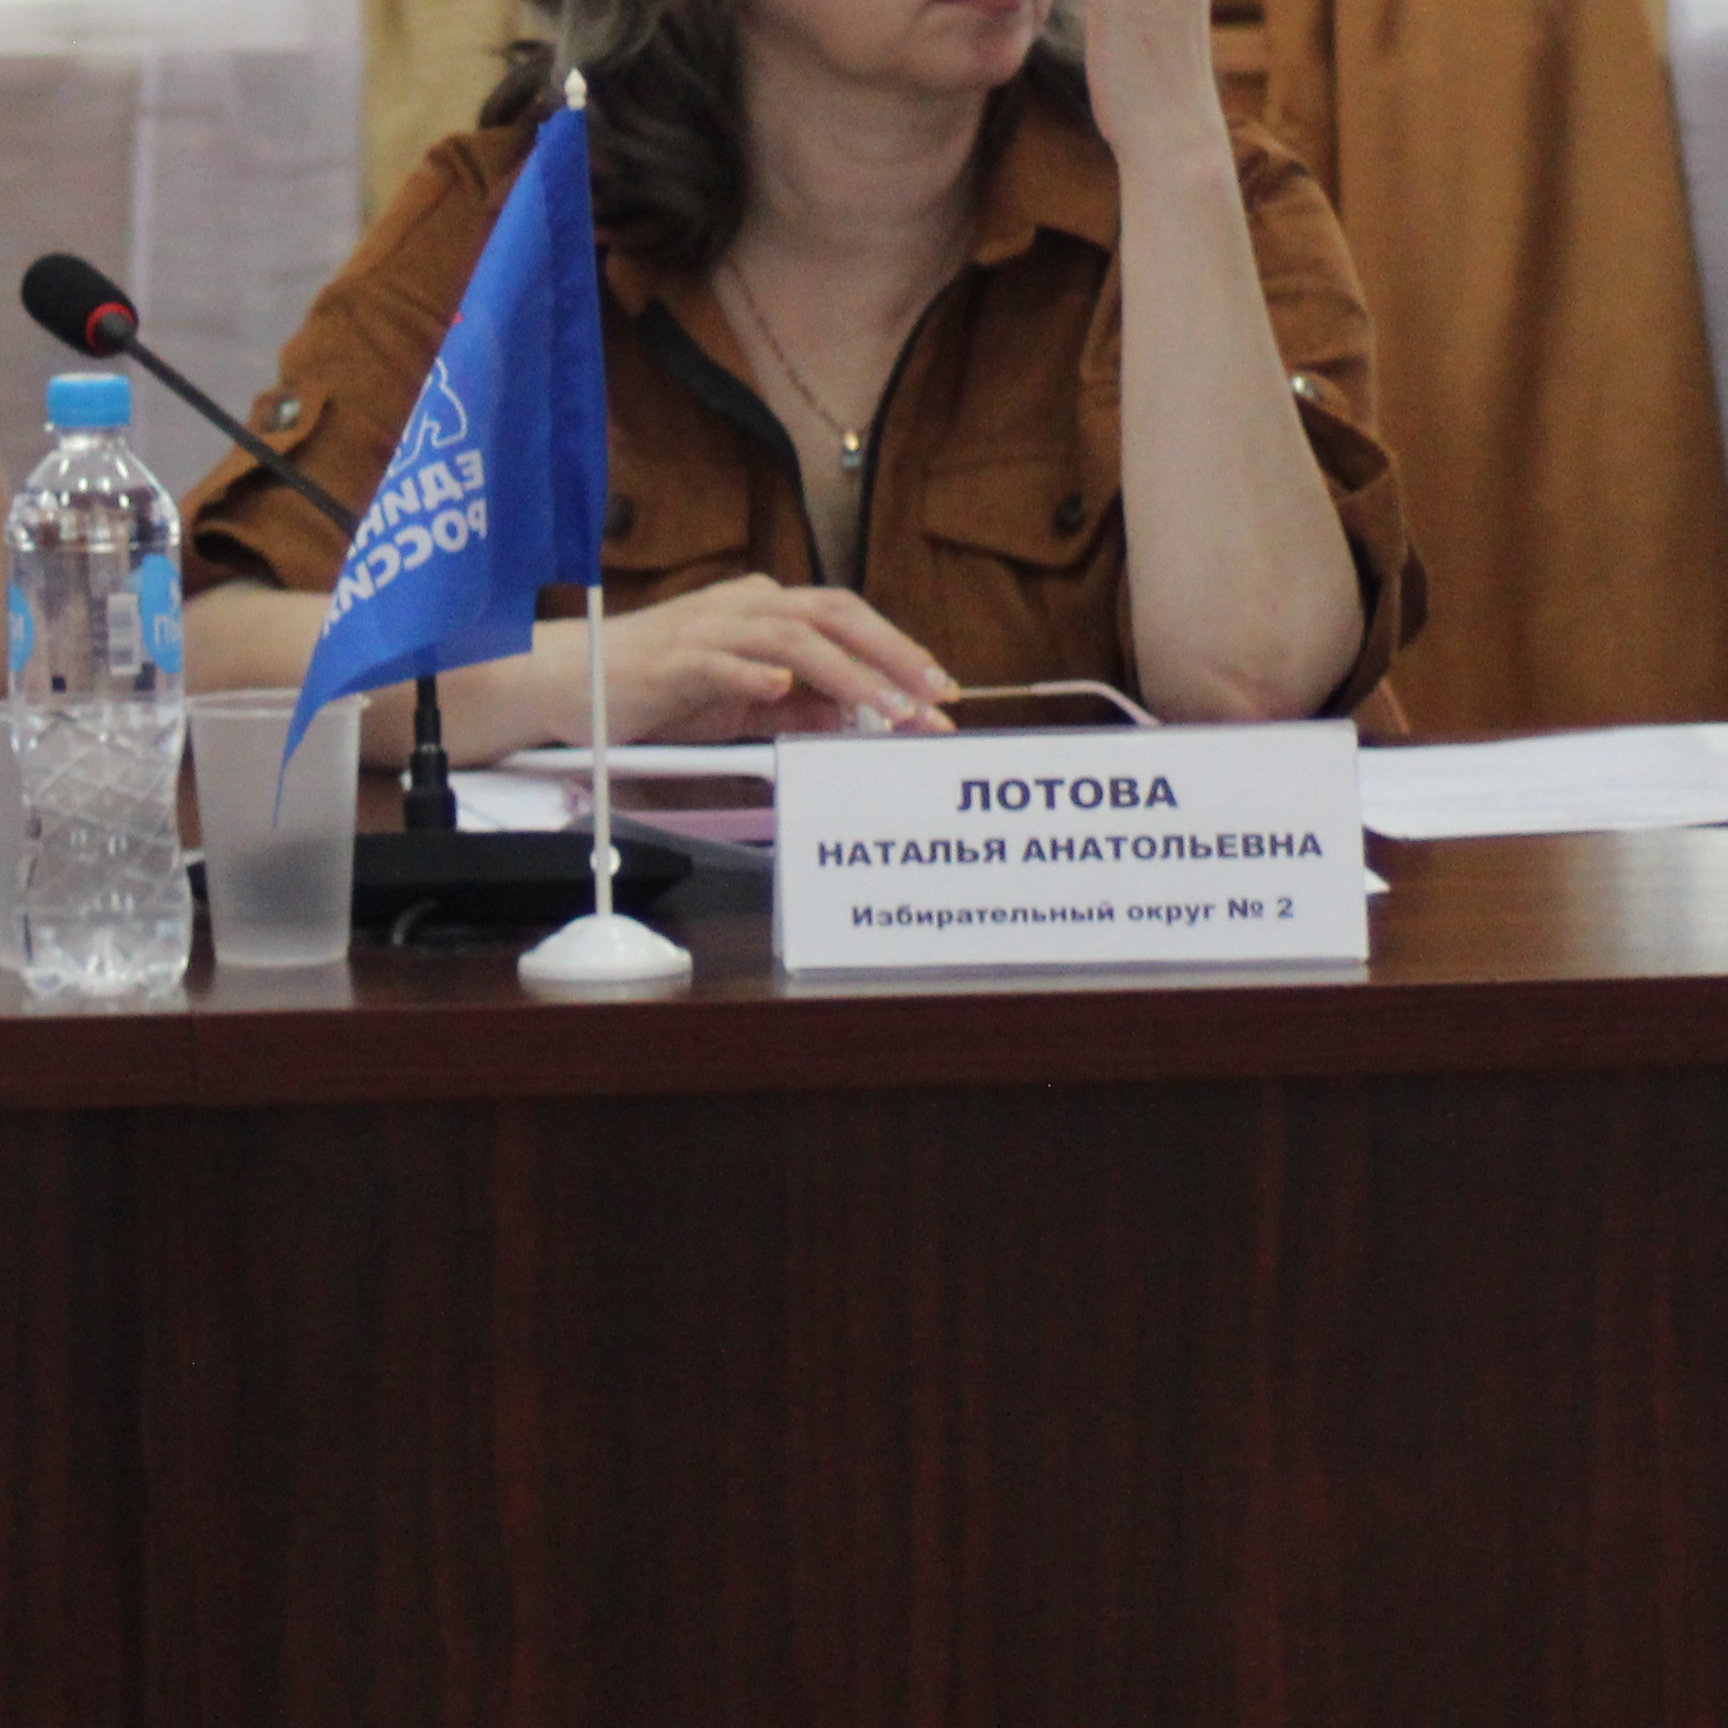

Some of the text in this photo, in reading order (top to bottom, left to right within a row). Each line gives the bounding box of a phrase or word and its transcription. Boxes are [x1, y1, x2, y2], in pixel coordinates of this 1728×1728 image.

[957, 775, 1178, 812] ЛОТОВА
[817, 832, 1323, 867] НАТАЛЬЯ АНАТОЛЬЕВНА
[851, 896, 1294, 931] Избирательный округ № 2
